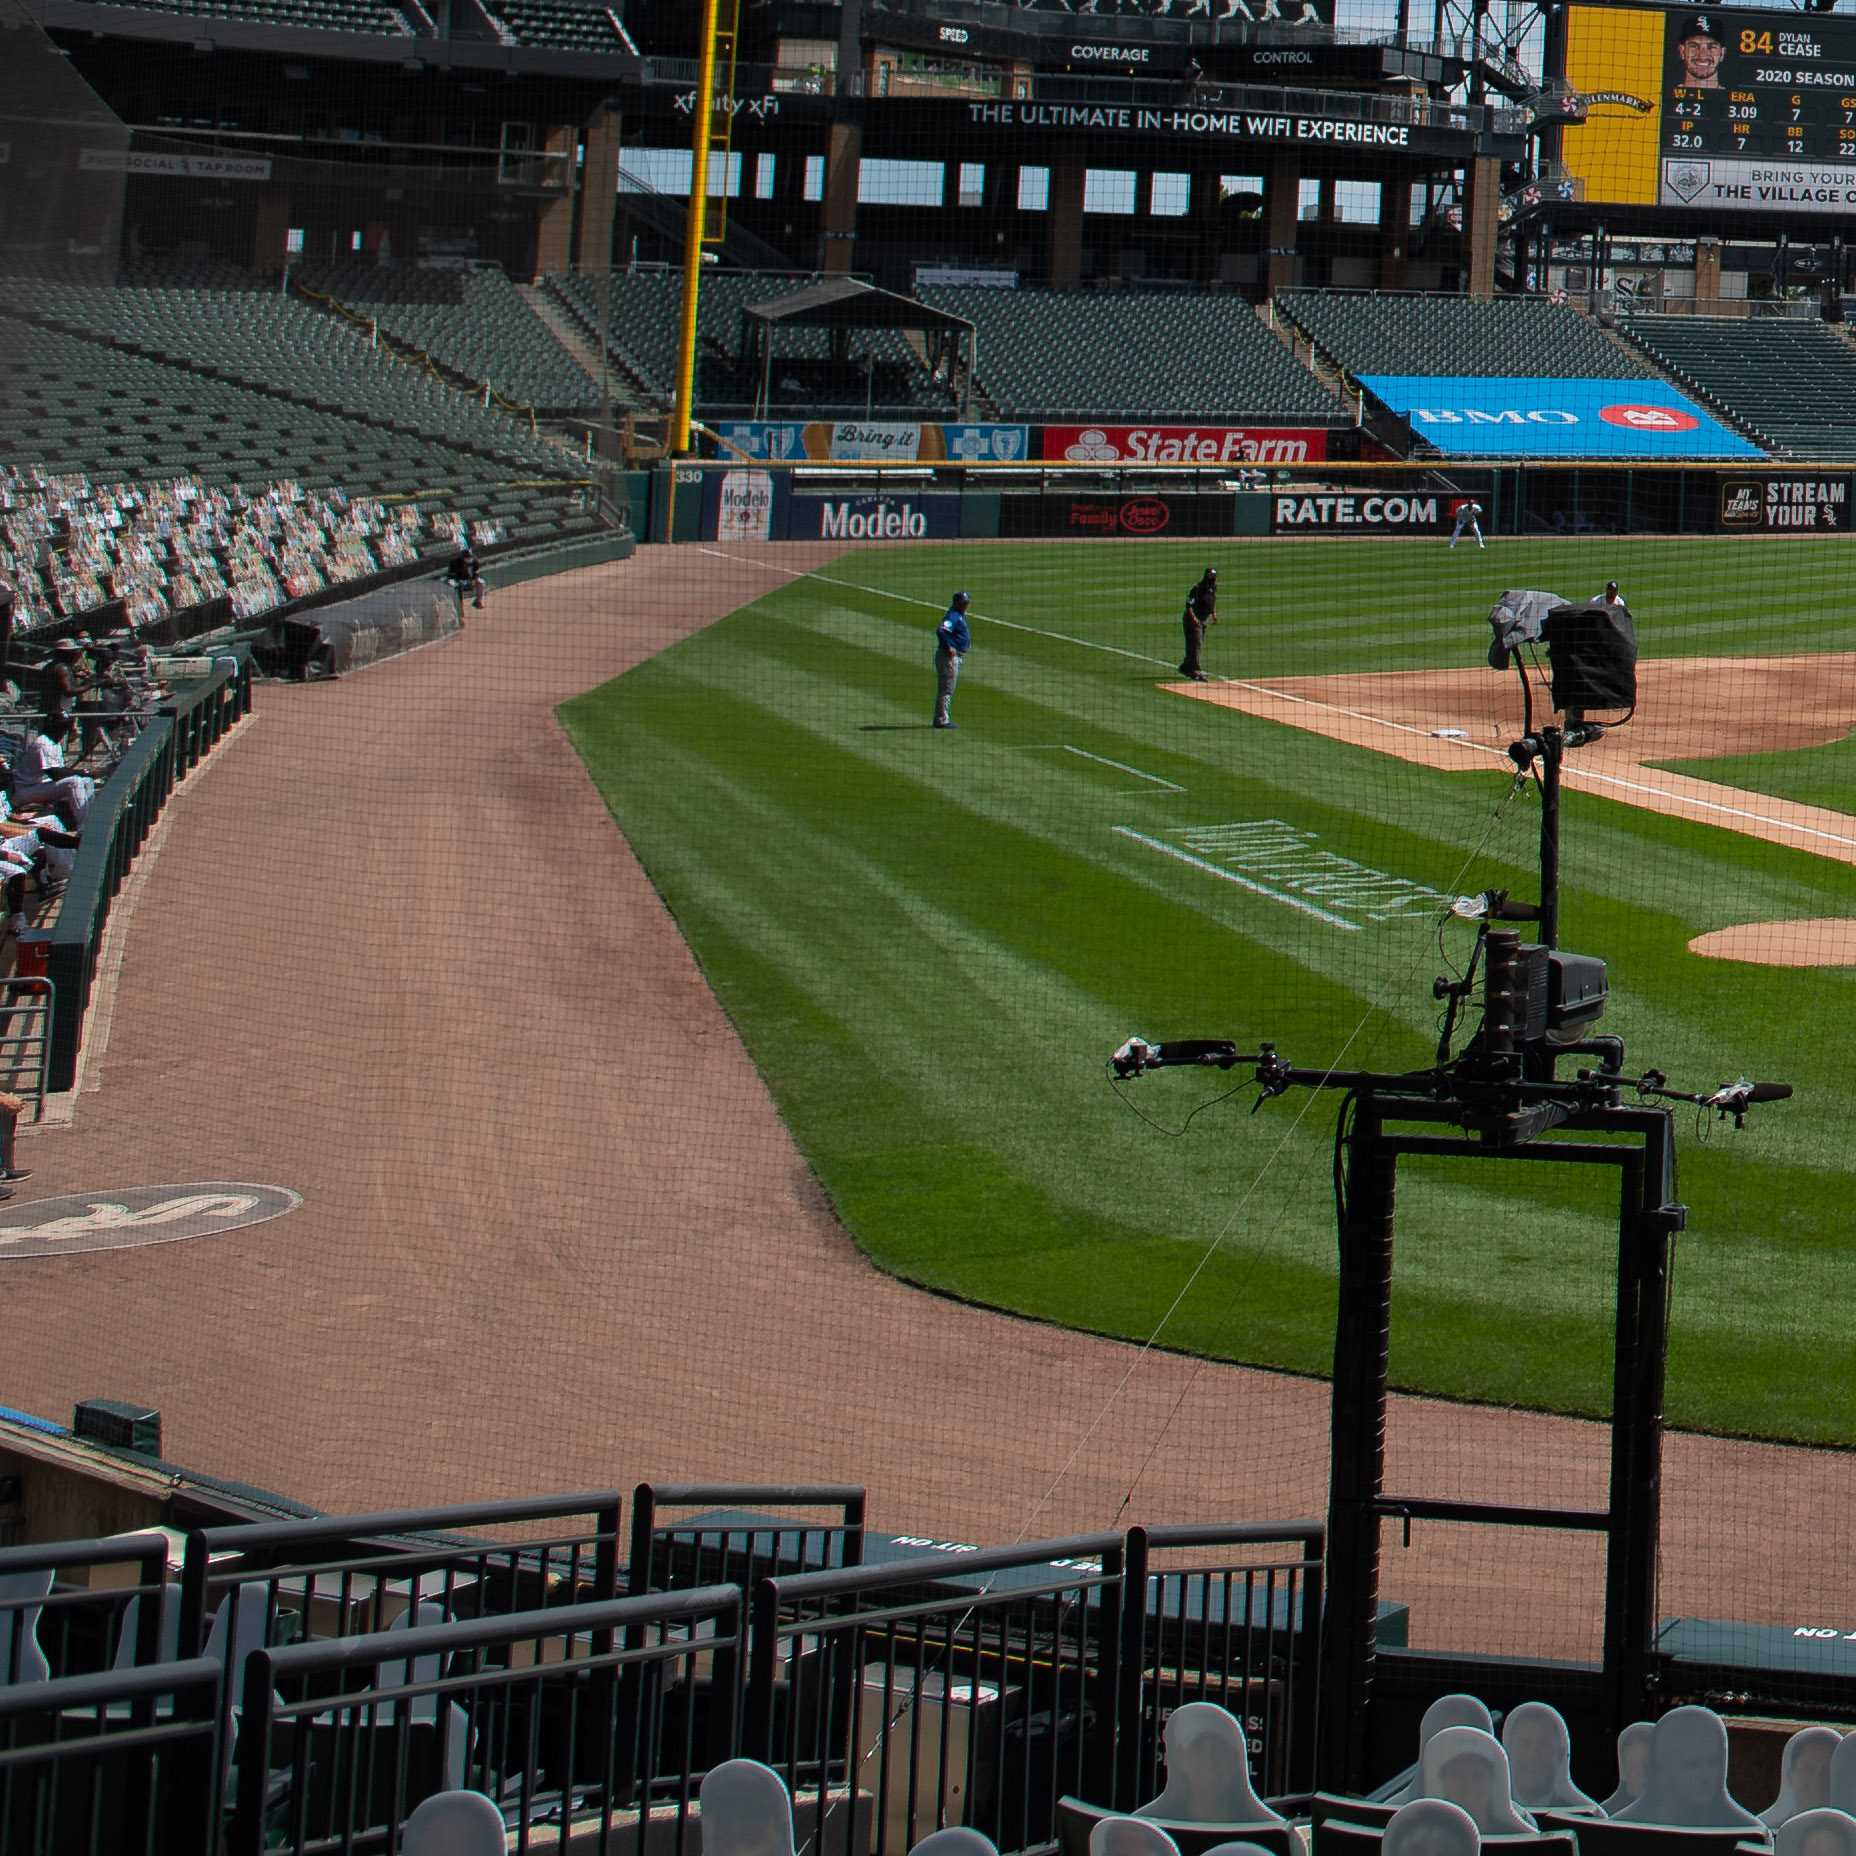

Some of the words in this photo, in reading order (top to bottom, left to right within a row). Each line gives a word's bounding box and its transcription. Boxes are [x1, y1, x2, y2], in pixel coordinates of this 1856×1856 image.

[1740, 30, 1774, 53] 84
[1779, 33, 1810, 43] DYLAN
[1071, 45, 1149, 62] COVERAGE
[1253, 51, 1312, 64] CONTROL
[1779, 43, 1821, 56] CEASE
[1756, 70, 1791, 82] 2020
[1796, 72, 1855, 86] SEASON
[970, 104, 1013, 123] THE
[1020, 106, 1130, 127] ULTIMATE
[1137, 110, 1240, 134] IN-HOME
[1247, 117, 1290, 137] WIFI
[1297, 119, 1408, 145] EXPERIENCE
[1752, 170, 1804, 182] BRING
[1810, 173, 1856, 185] YOUR
[1714, 185, 1751, 199] THE
[1758, 186, 1840, 203] VILLAGE
[1409, 409, 1579, 424] BMO
[675, 472, 702, 482] 330
[1766, 482, 1844, 503] STREAM
[1275, 497, 1437, 523] RATE.COM
[1766, 506, 1817, 526] YOUR
[822, 502, 927, 538] Modelo
[1793, 1627, 1839, 1638] ON
